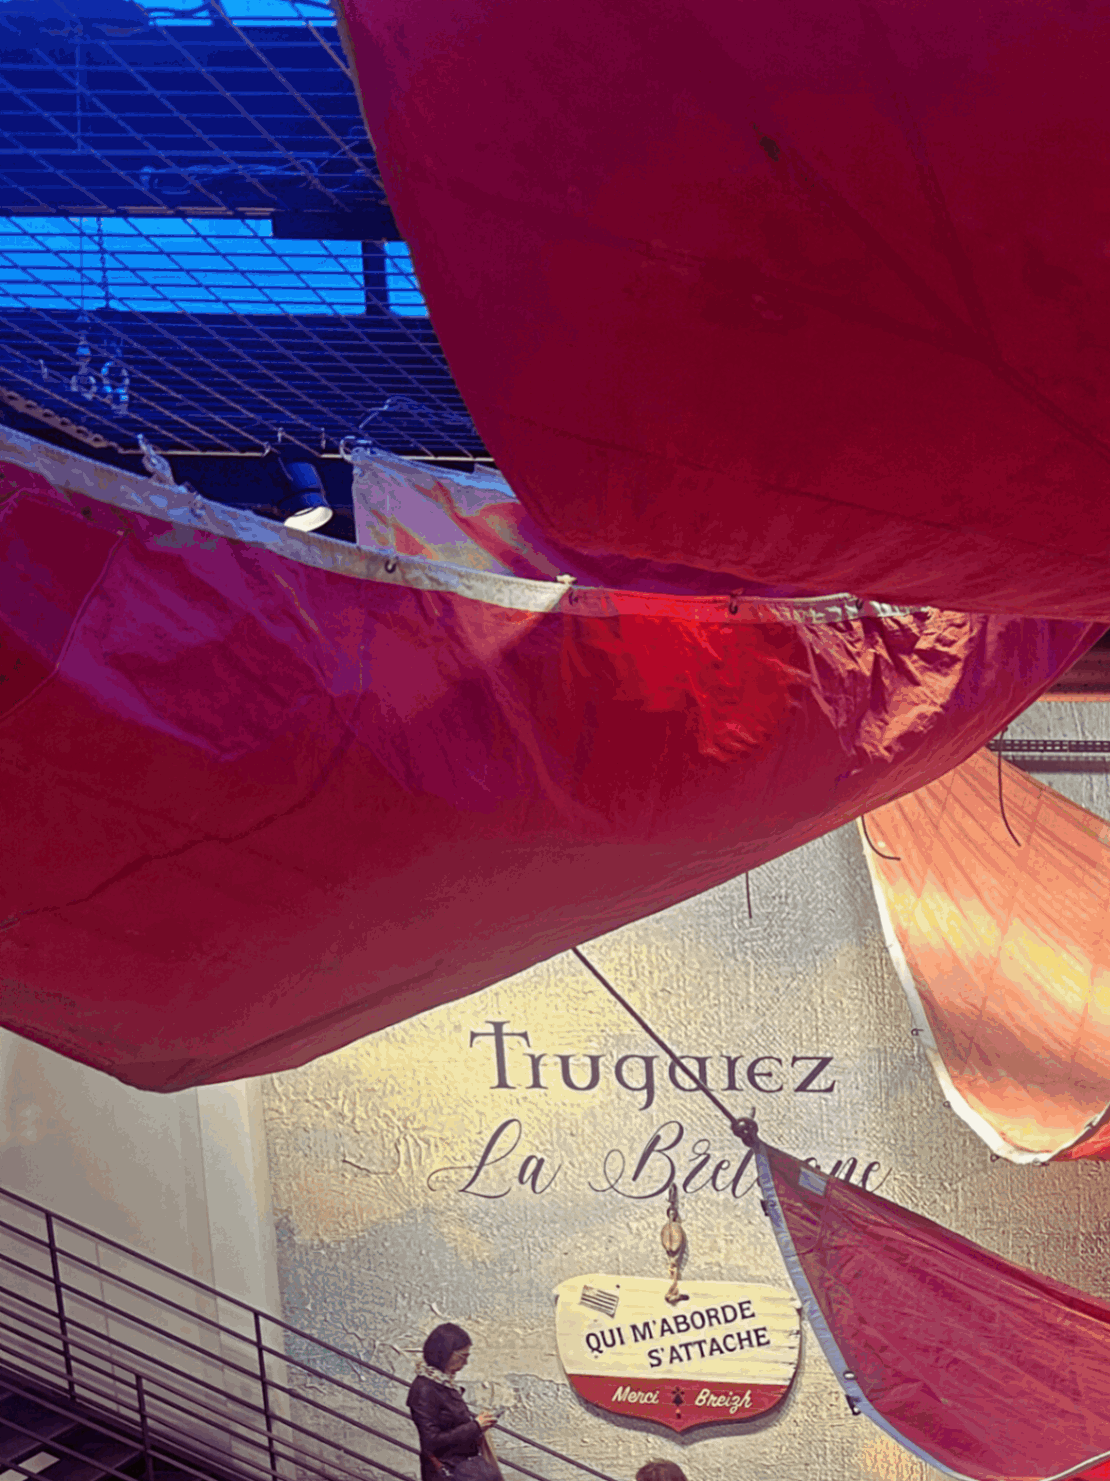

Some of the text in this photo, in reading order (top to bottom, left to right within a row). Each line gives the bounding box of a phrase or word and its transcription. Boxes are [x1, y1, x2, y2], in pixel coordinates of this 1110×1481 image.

[469, 1020, 836, 1111] Trugarez
[427, 1106, 892, 1200] La Bretne
[585, 1300, 756, 1353] QUI M'ABORDE
[647, 1327, 771, 1368] S'ATTACHE
[611, 1386, 753, 1414] Merci Breizh
